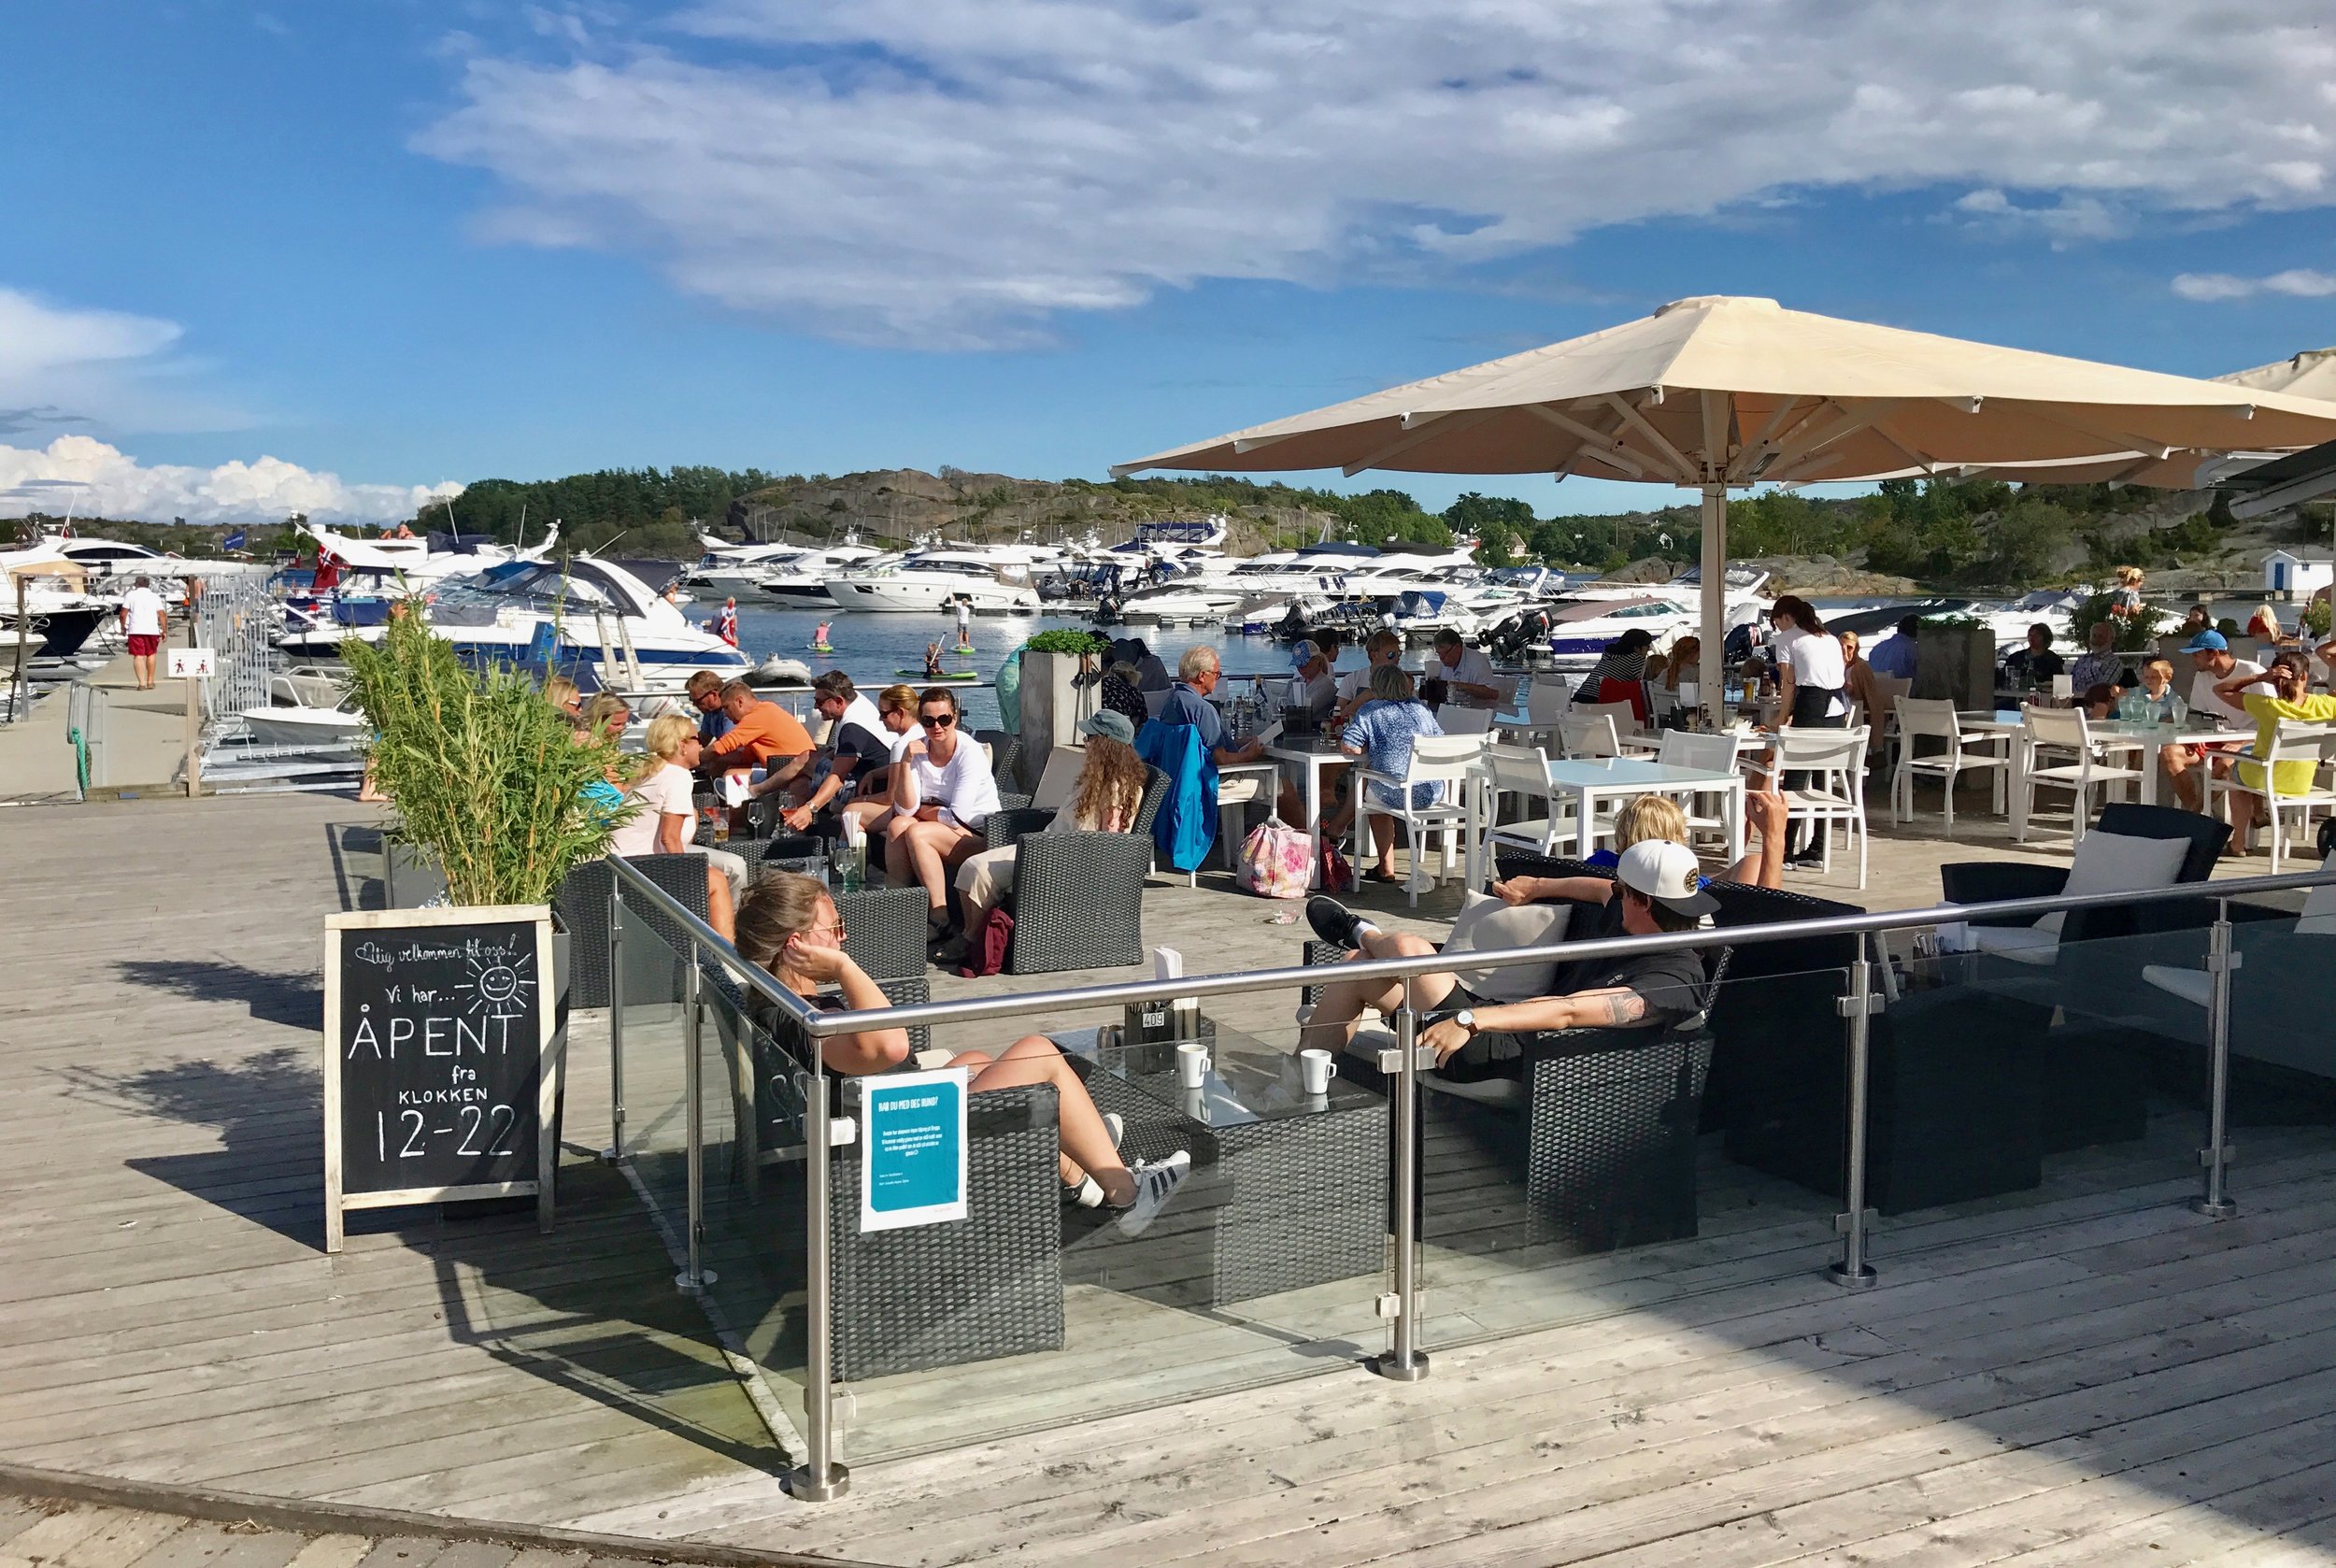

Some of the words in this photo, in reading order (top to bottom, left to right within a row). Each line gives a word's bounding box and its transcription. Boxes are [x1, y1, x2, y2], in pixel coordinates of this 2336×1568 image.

[398, 943, 462, 962] velkommen
[466, 937, 481, 958] til
[484, 933, 517, 956] oss!
[385, 984, 402, 1004] Vi
[1144, 1014, 1162, 1026] 409
[348, 1003, 523, 1061] ÅPENT
[451, 1064, 477, 1085] fra
[398, 1087, 489, 1105] KLOKKEN
[377, 1104, 516, 1162] 12-22
